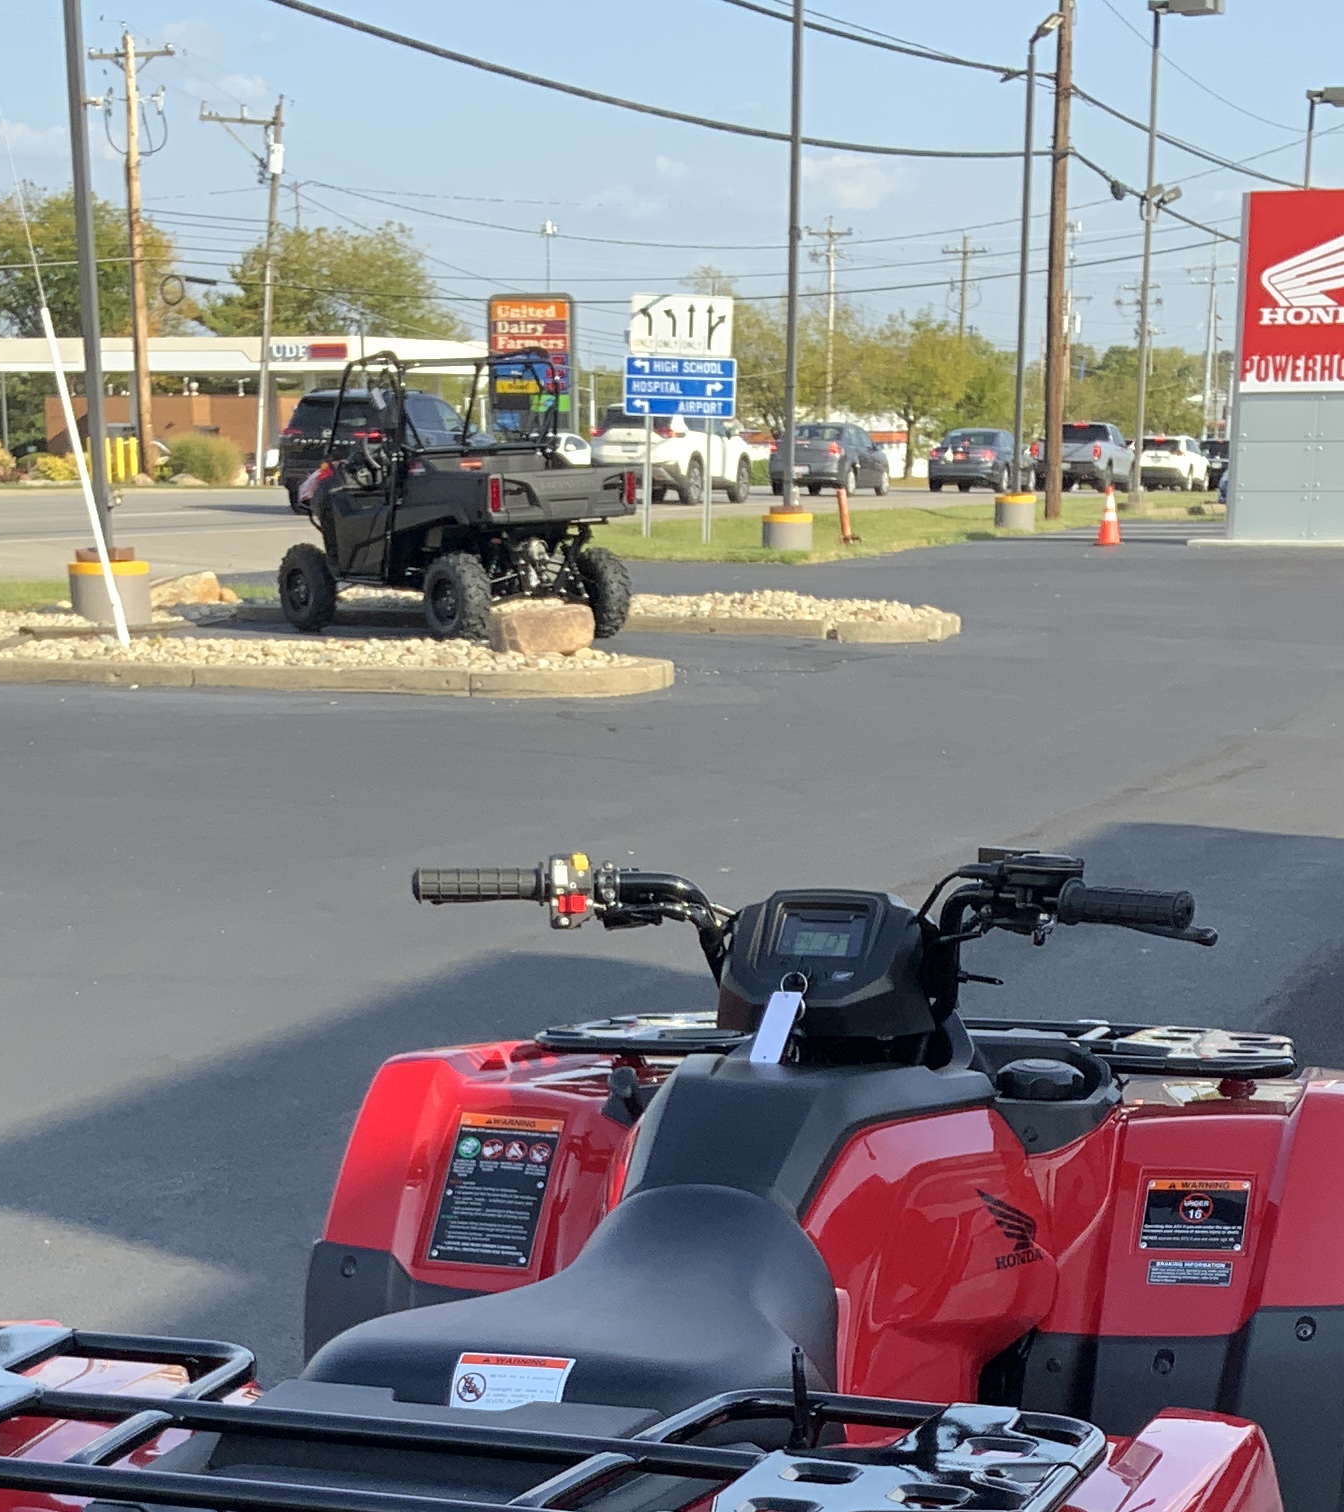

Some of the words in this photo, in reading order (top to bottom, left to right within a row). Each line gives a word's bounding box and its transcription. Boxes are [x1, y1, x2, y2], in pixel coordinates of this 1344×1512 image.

[497, 305, 556, 318] United
[497, 321, 545, 334] Dairy
[497, 337, 565, 349] Farmers
[272, 344, 309, 358] UDF
[653, 361, 678, 373] HIGH
[683, 362, 724, 374] SCHOOL
[632, 380, 683, 394] HOSPITAL
[677, 402, 723, 414] AIRPORT
[493, 1118, 536, 1128] WARNING
[1181, 1181, 1230, 1189] WARNING
[1188, 1209, 1202, 1219] 16
[995, 1248, 1043, 1270] HONDA
[496, 1357, 547, 1366] WARNING
